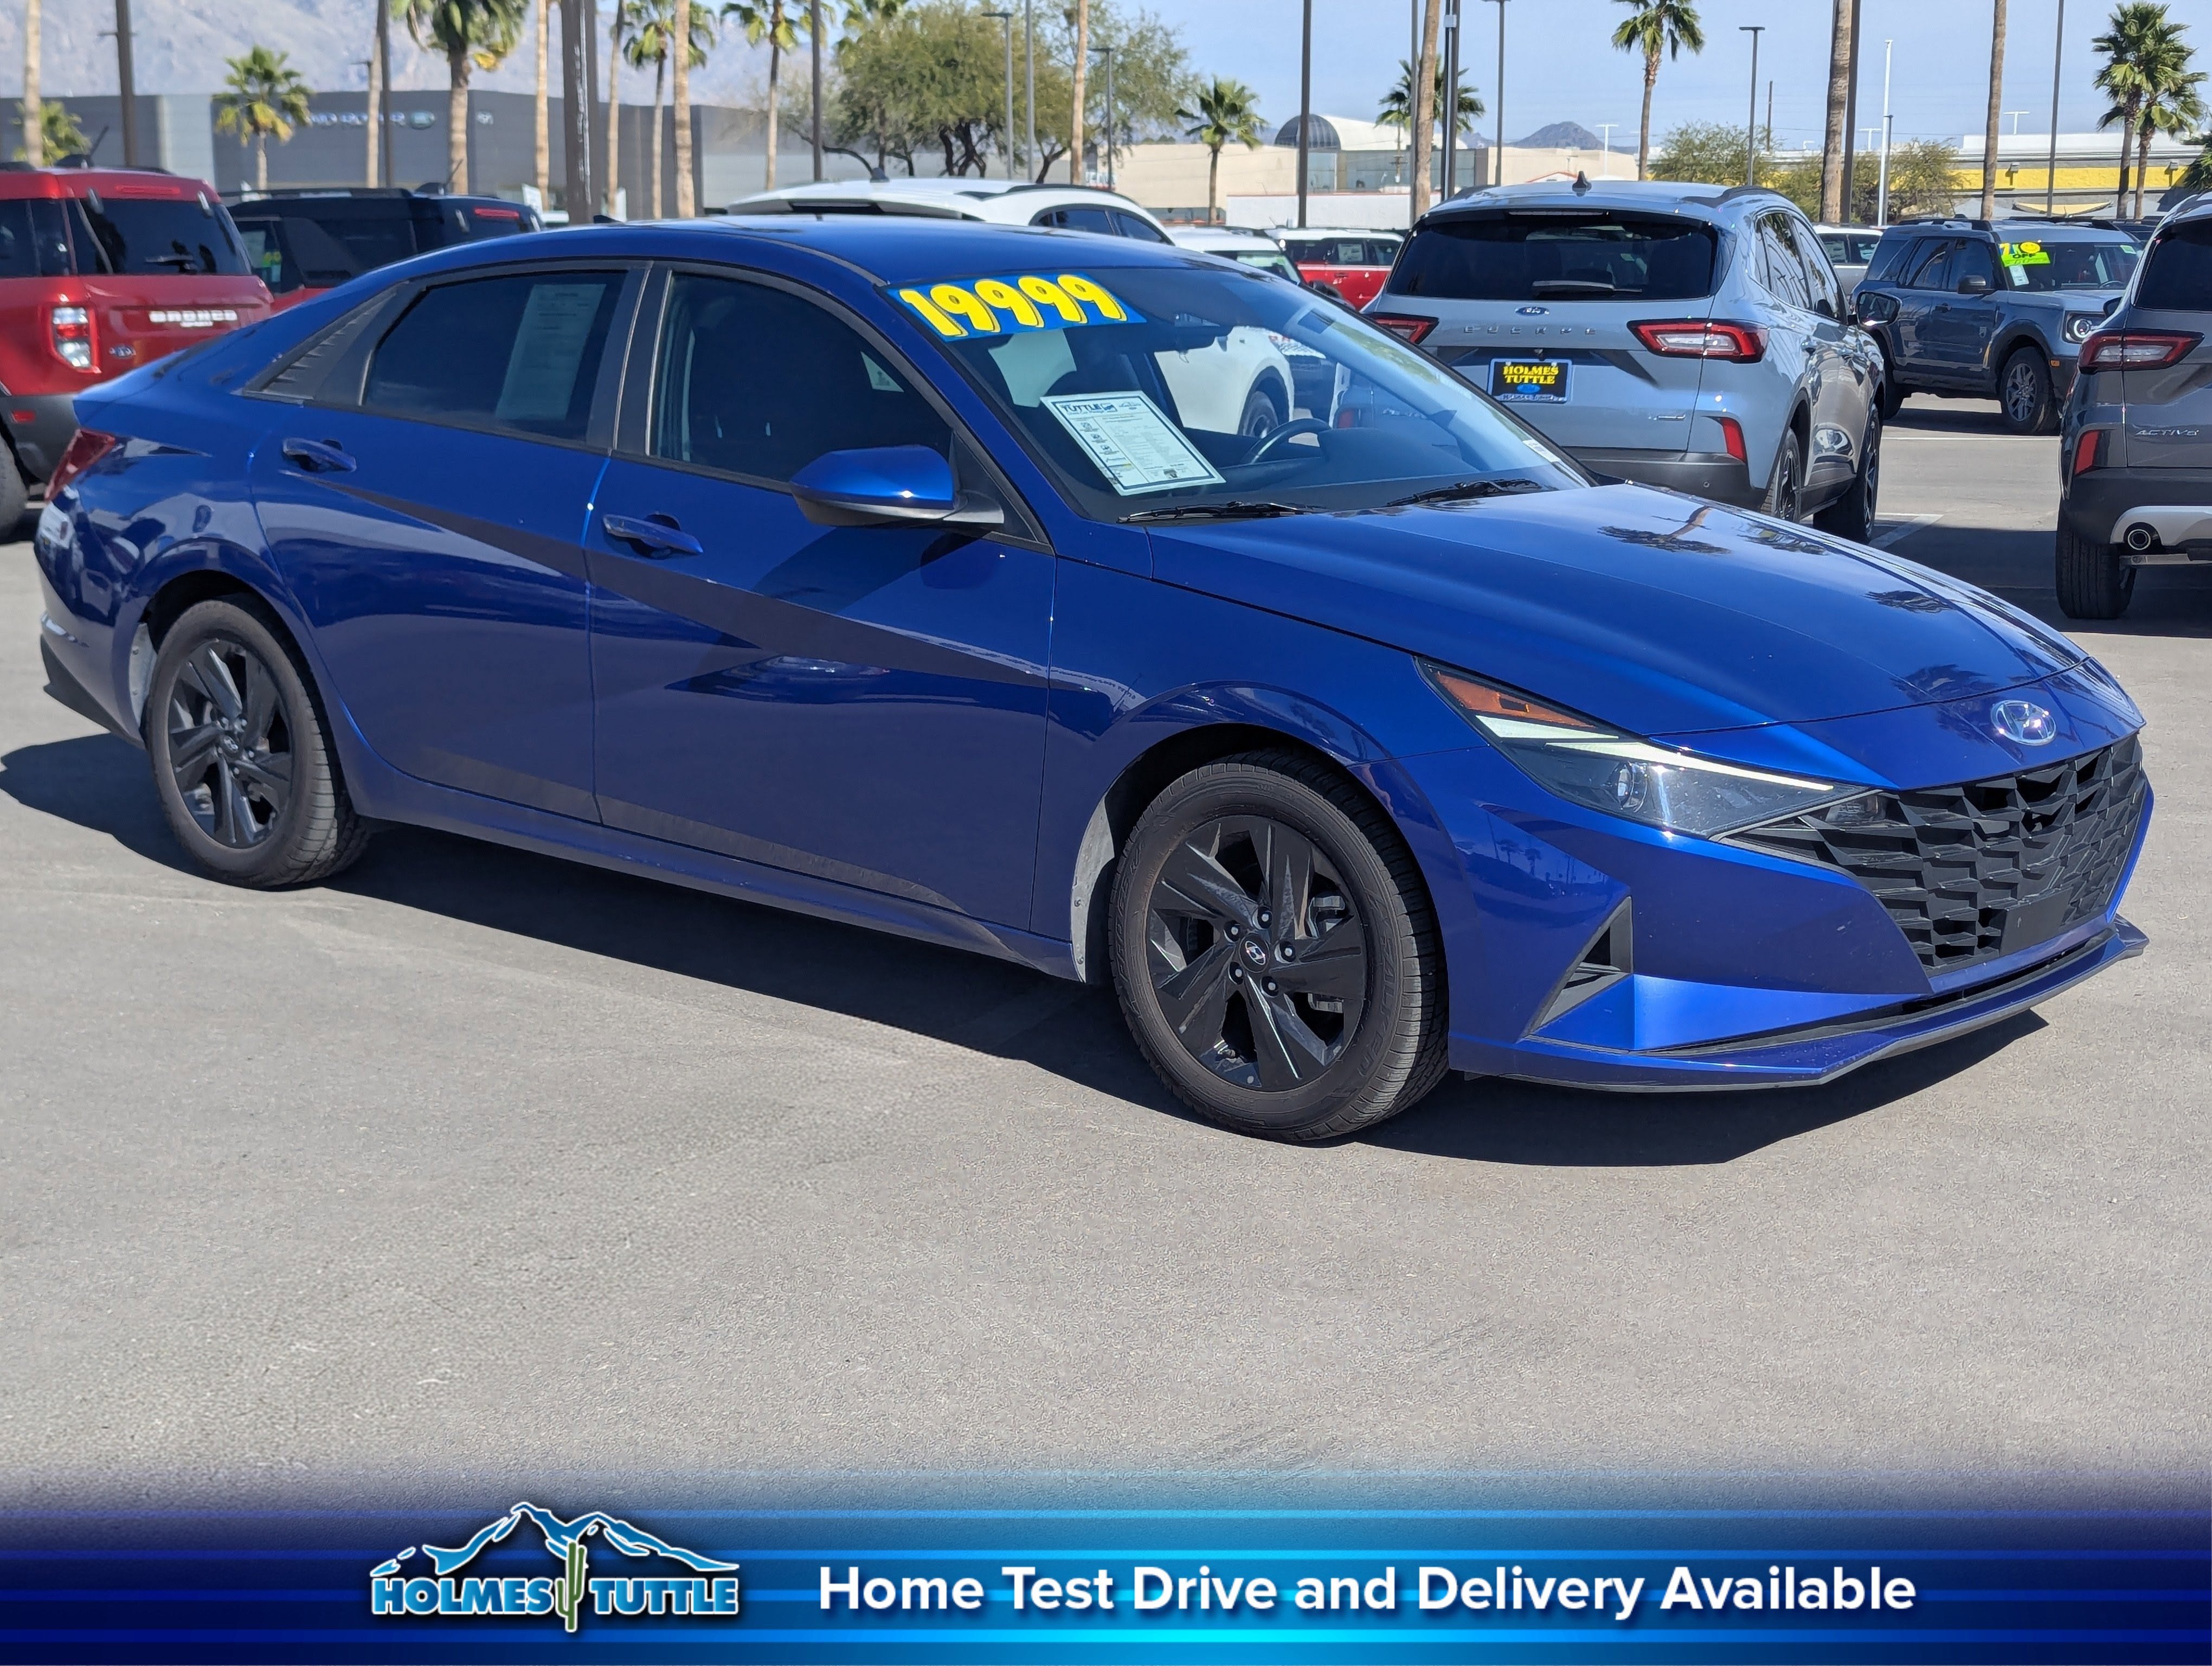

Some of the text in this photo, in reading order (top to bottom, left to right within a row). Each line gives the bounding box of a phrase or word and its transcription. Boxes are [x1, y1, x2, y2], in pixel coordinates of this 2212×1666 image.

[899, 274, 1127, 337] 19999
[1503, 366, 1559, 375] HOLMES
[1504, 375, 1555, 384] TUTTLE
